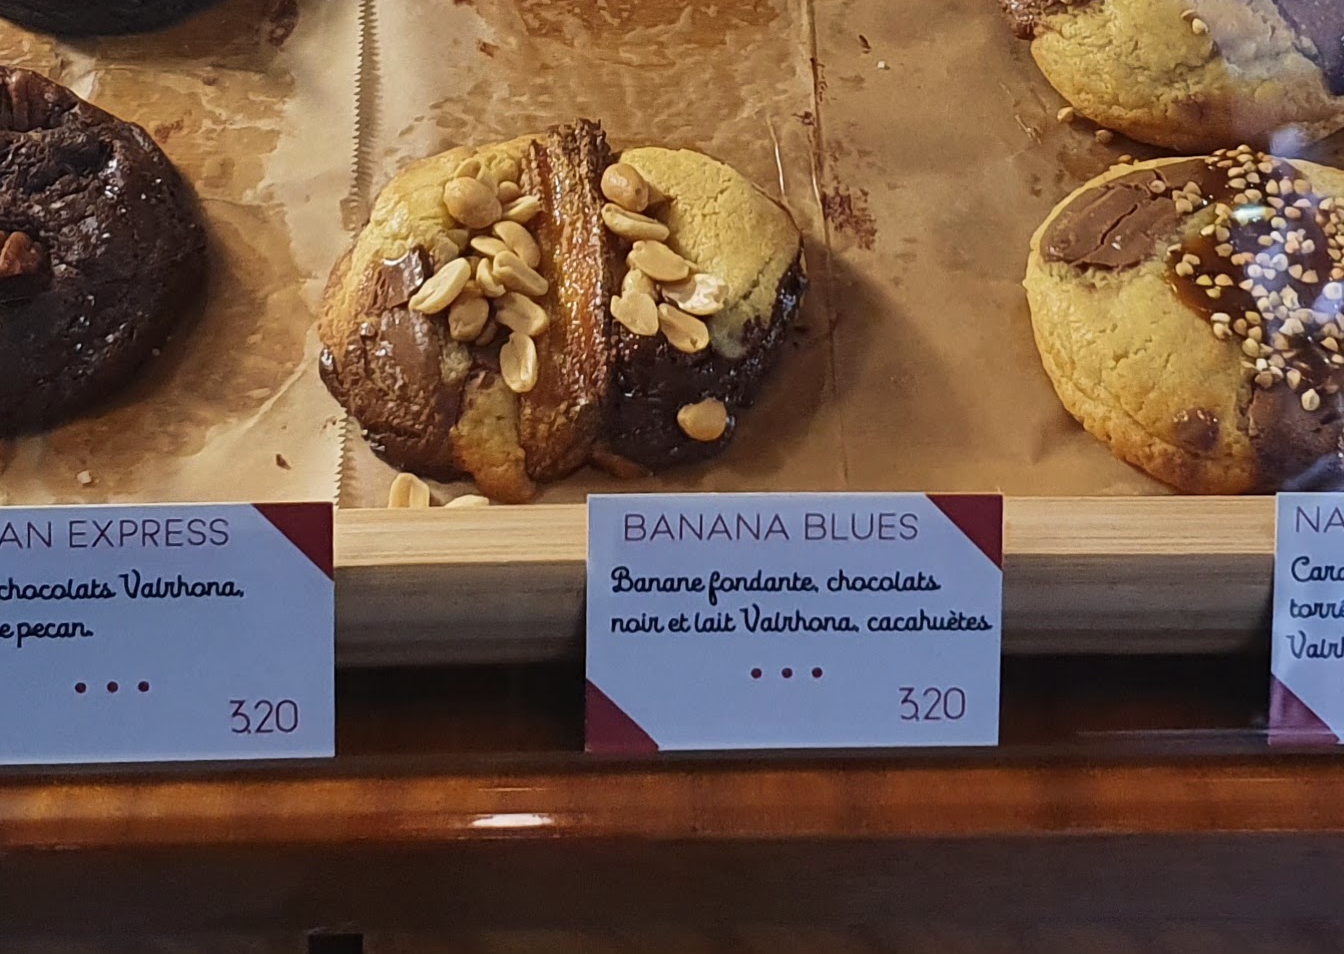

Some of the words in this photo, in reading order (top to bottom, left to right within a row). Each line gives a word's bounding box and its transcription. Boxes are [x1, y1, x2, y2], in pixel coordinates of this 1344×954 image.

[68, 517, 231, 548] EXPRESS
[623, 512, 791, 542] BANANA
[803, 511, 920, 541] BLUES
[610, 565, 705, 593] Banane
[706, 568, 820, 606] fondante,
[826, 568, 942, 592] chocolats
[610, 612, 665, 634] noir
[666, 613, 691, 634] et
[692, 612, 737, 634] lait
[738, 603, 860, 634] Valrhona,
[866, 608, 994, 633] cacahuètes
